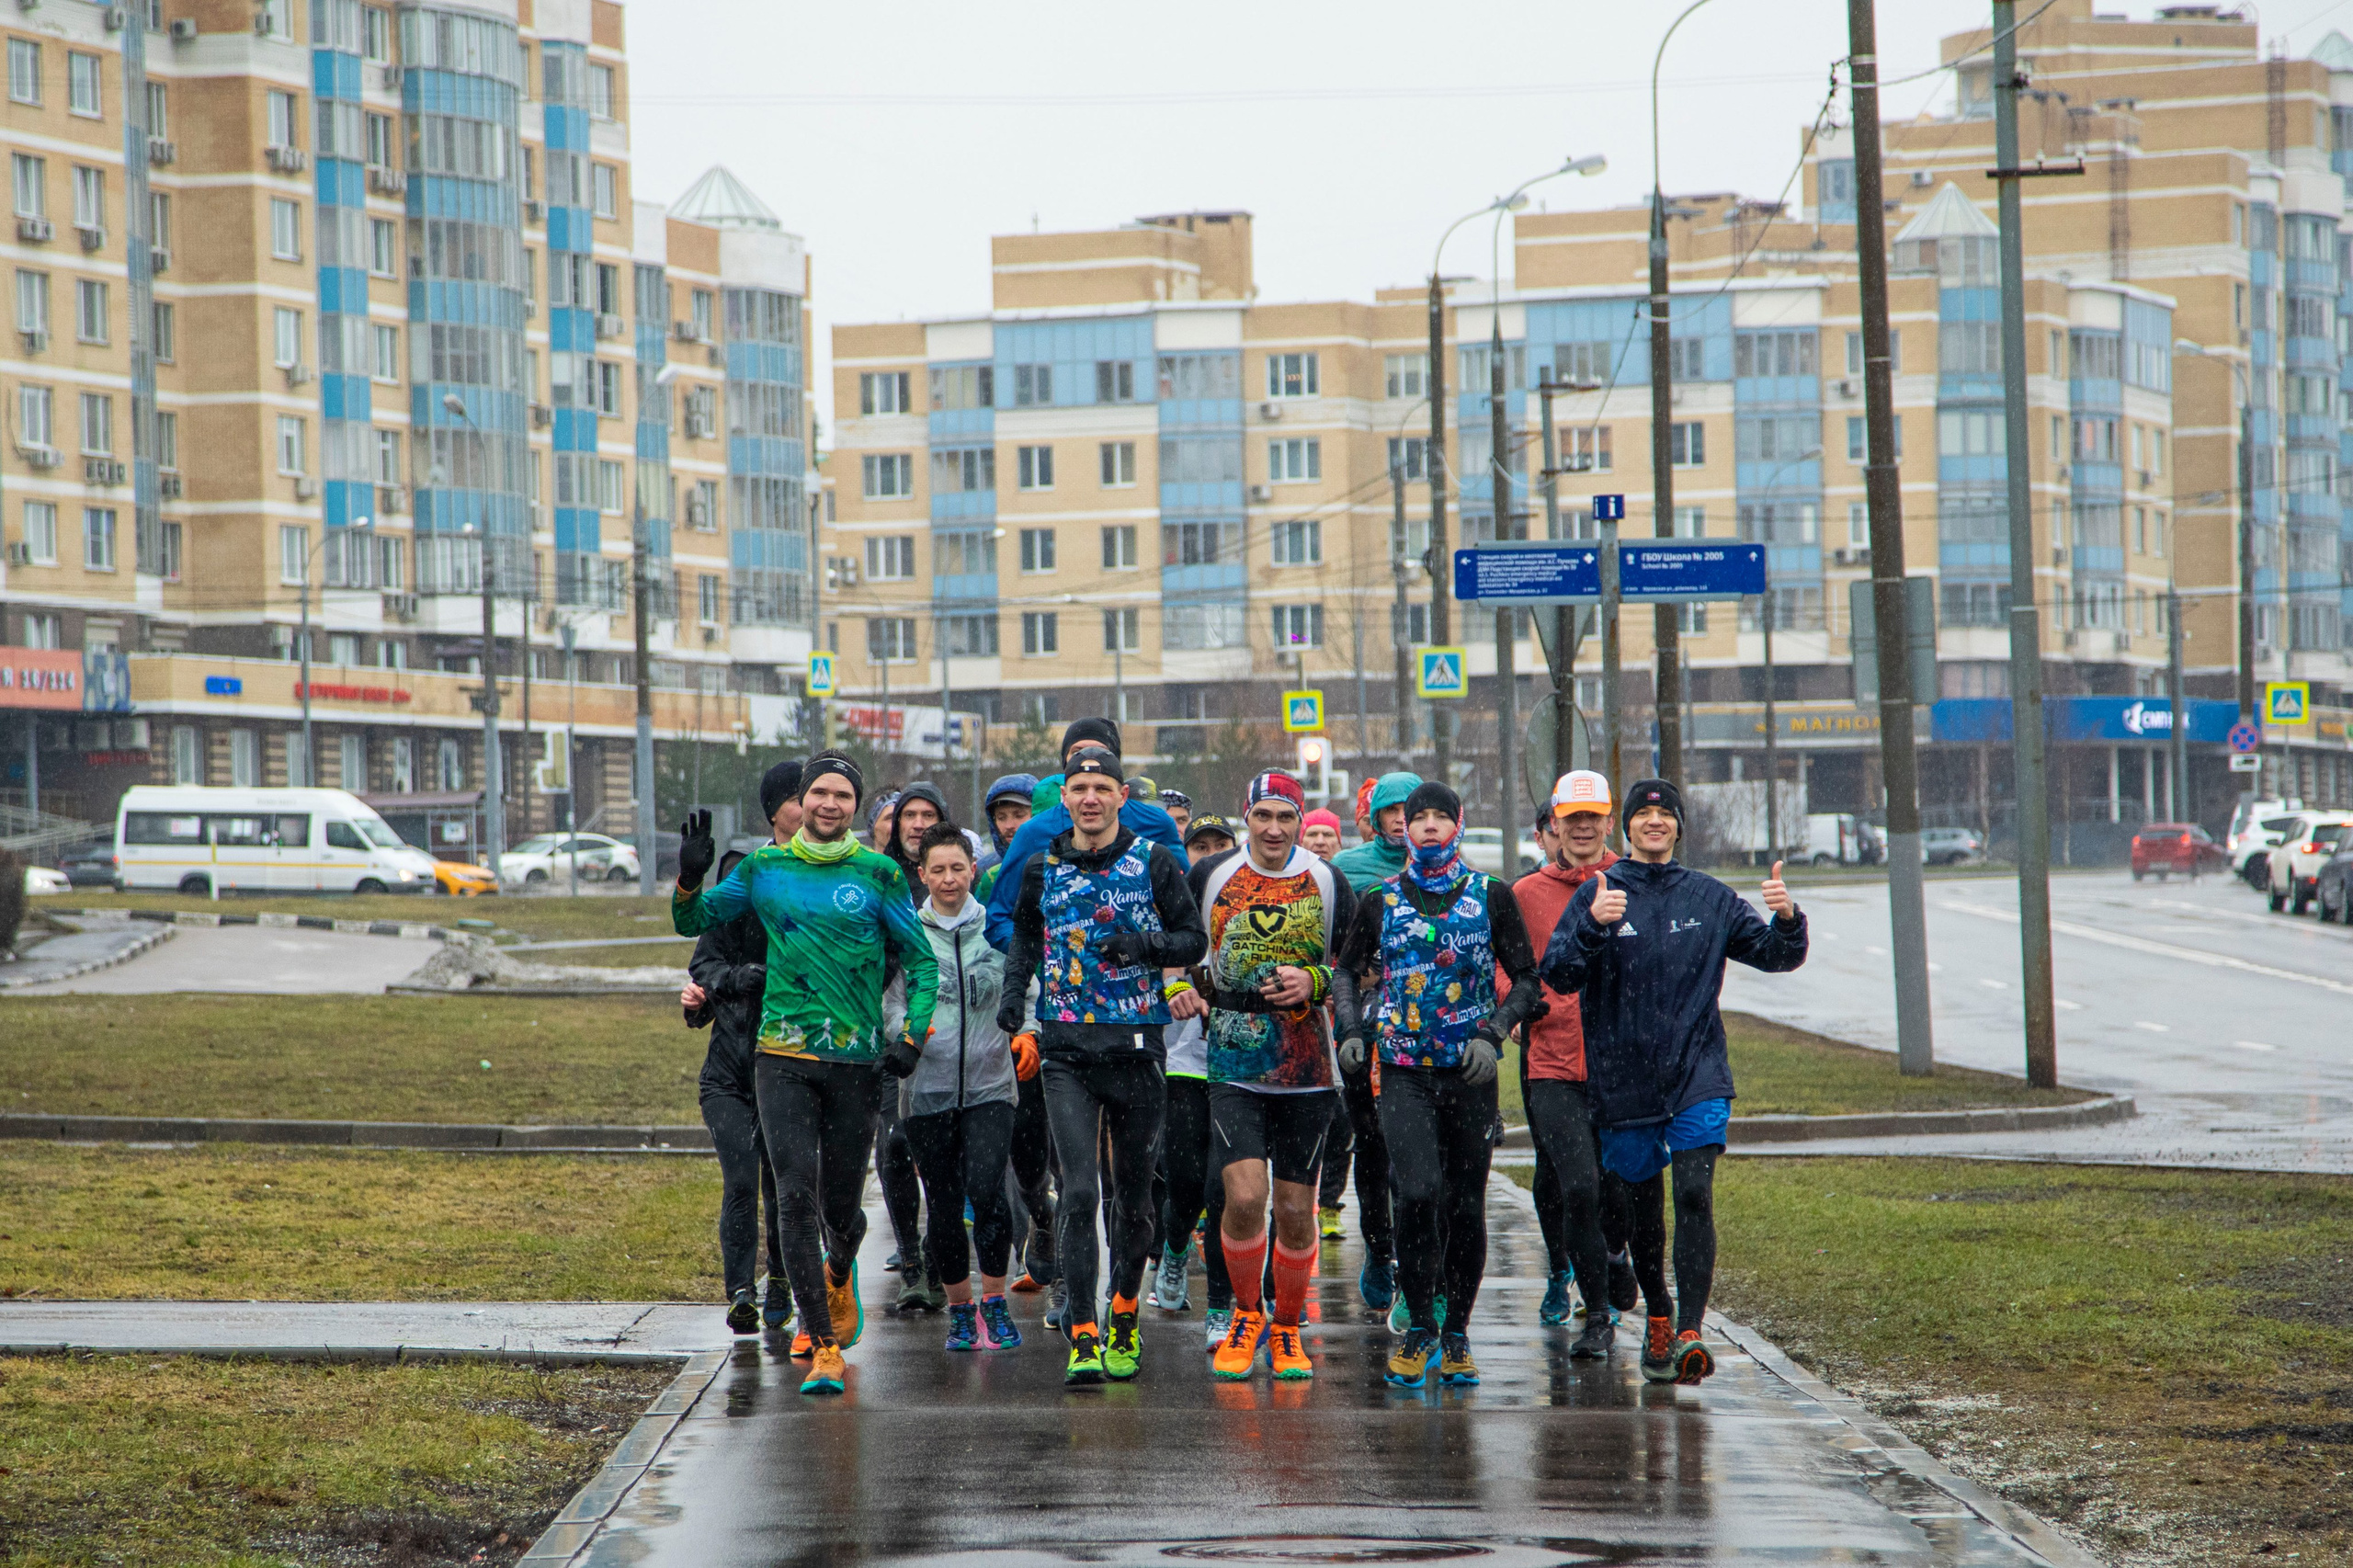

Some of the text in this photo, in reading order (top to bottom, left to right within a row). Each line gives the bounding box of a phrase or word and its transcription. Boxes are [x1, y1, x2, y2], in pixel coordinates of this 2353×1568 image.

[1641, 551, 1723, 562] ГБОУ Школа № 2005
[1232, 941, 1297, 955] GATCHINA
[1250, 953, 1278, 962] RUN
